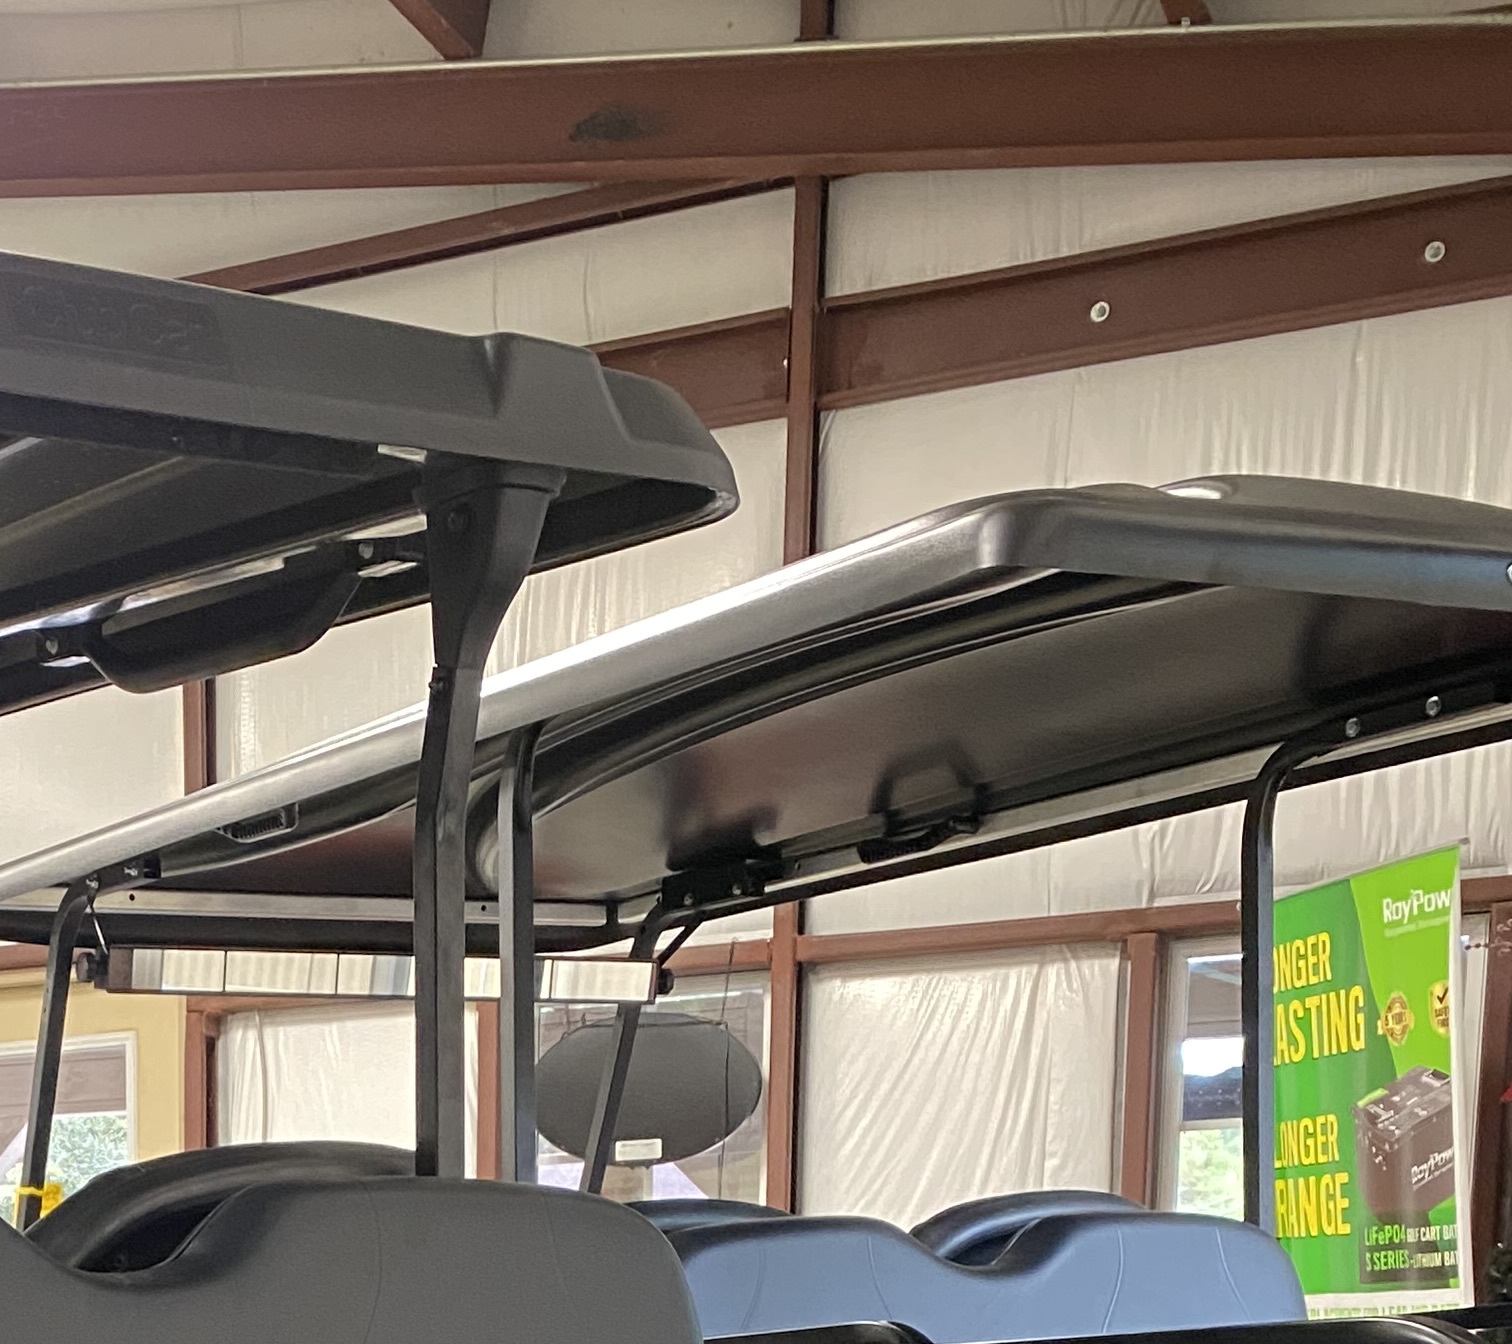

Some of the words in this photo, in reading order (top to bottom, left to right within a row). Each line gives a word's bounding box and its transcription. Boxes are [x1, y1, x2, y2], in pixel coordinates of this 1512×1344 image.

[1273, 932, 1332, 994] ONGER
[1273, 985, 1366, 1066] ASTING
[1274, 1172, 1351, 1238] RANGE
[1420, 1225, 1441, 1242] CART
[1373, 1250, 1410, 1271] SERIES
